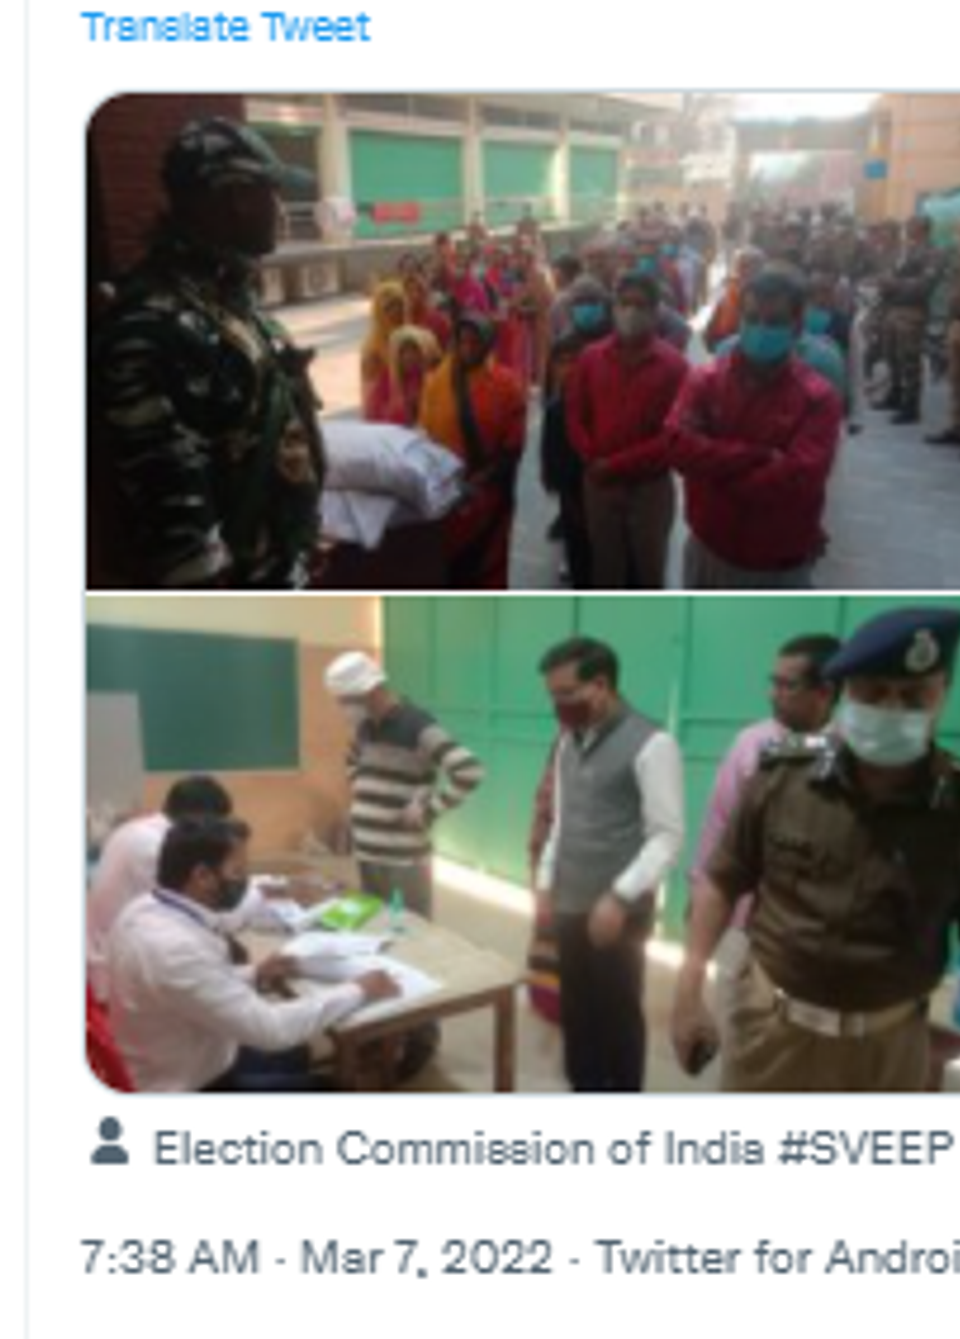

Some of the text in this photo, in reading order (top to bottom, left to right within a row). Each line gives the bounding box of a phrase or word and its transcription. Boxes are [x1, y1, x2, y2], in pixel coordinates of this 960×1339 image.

[80, 11, 371, 42] Translate Tweet
[156, 1130, 322, 1165] Election
[337, 1130, 593, 1165] Commission
[609, 1130, 651, 1165] of
[667, 1131, 764, 1165] India
[779, 1130, 954, 1165] #SVEEP
[81, 1239, 175, 1274] 7:38
[189, 1240, 258, 1273] AM
[303, 1240, 384, 1274] Mar
[395, 1239, 427, 1278] 7,
[443, 1239, 551, 1274] 2022
[595, 1239, 741, 1274] Twitter
[754, 1239, 812, 1274] for
